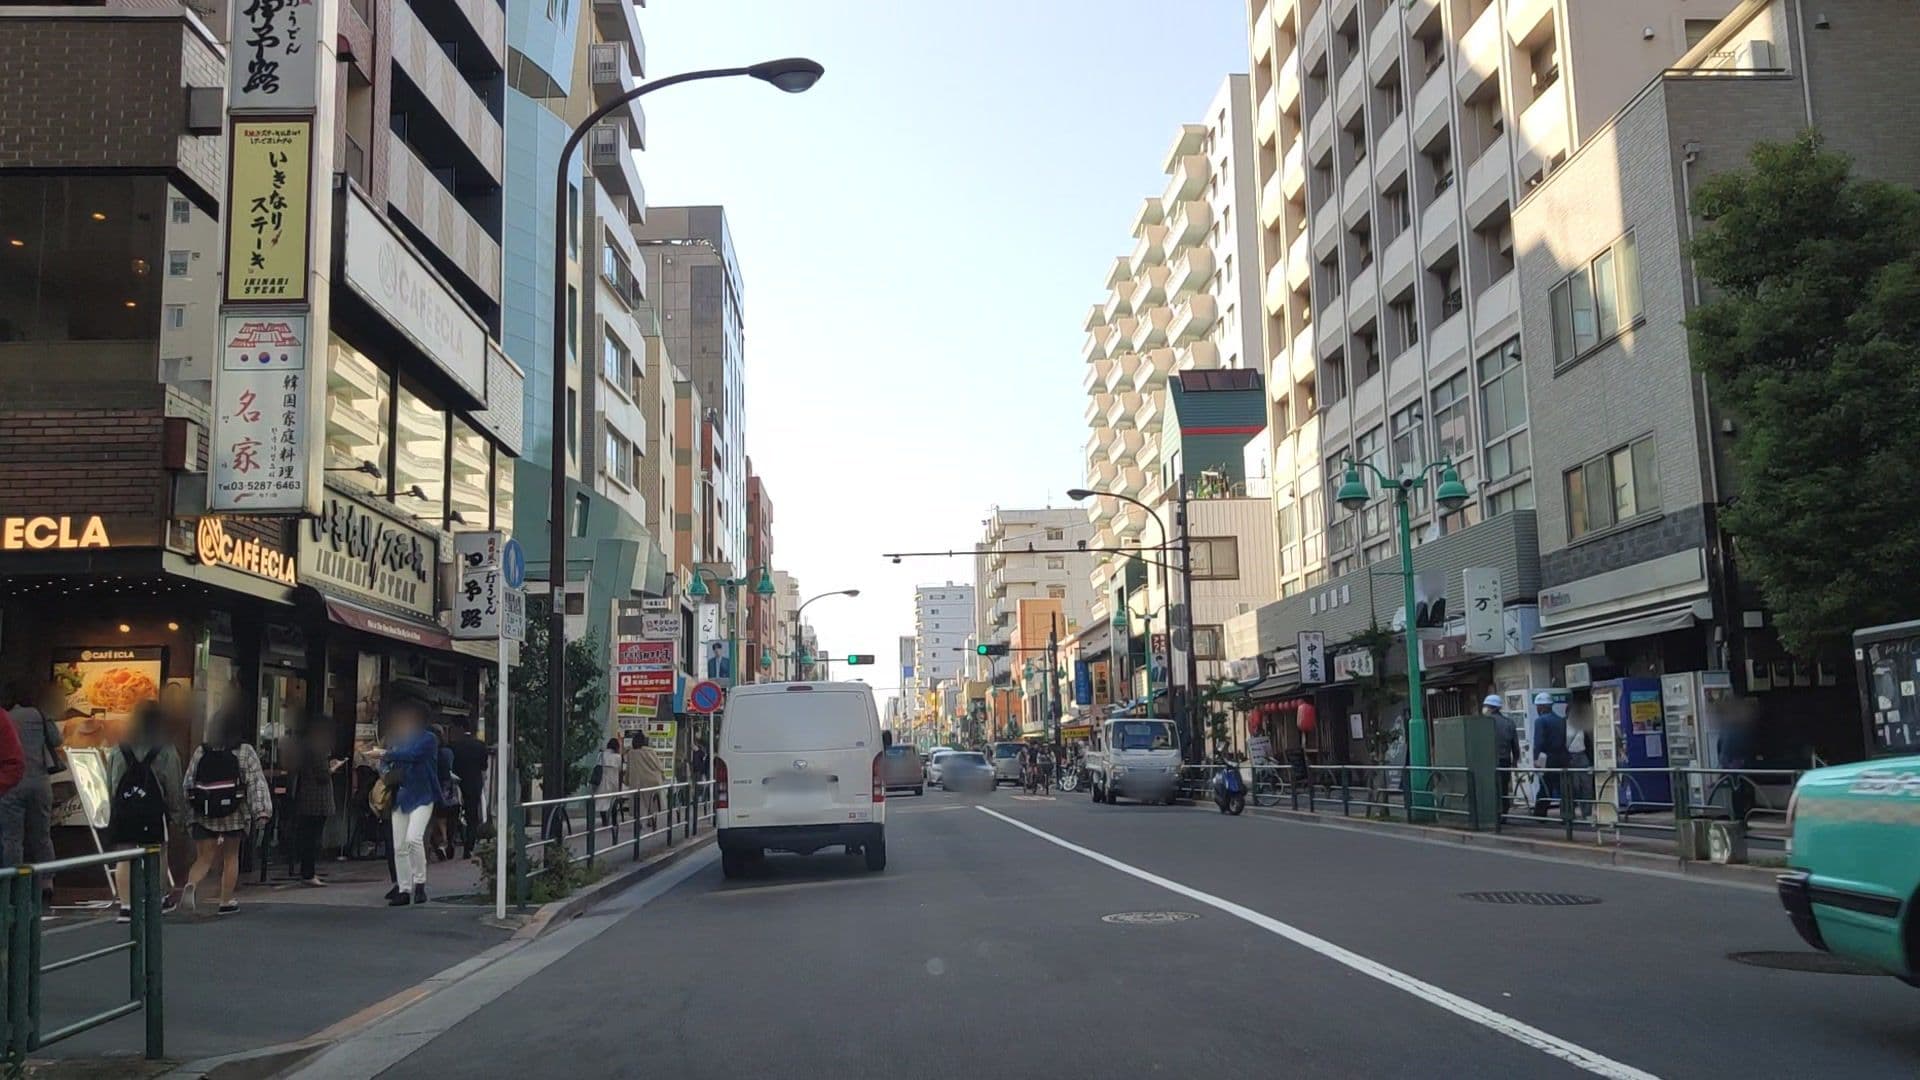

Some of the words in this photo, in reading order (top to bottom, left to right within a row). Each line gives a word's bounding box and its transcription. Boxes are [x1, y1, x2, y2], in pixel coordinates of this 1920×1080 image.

[269, 151, 288, 231] いきなり
[250, 197, 268, 270] ステーキ
[244, 278, 289, 286] IKINARI
[244, 286, 285, 294] STEAK
[231, 389, 262, 474] 名家
[279, 374, 299, 479] 韓国家庭料理
[4, 516, 110, 549] ECLA
[221, 537, 260, 572] CAFÉ
[260, 549, 298, 584] ECLA
[316, 548, 368, 588] IKINARI
[378, 571, 417, 605] STEAK
[1306, 642, 1321, 682] 中央苑
